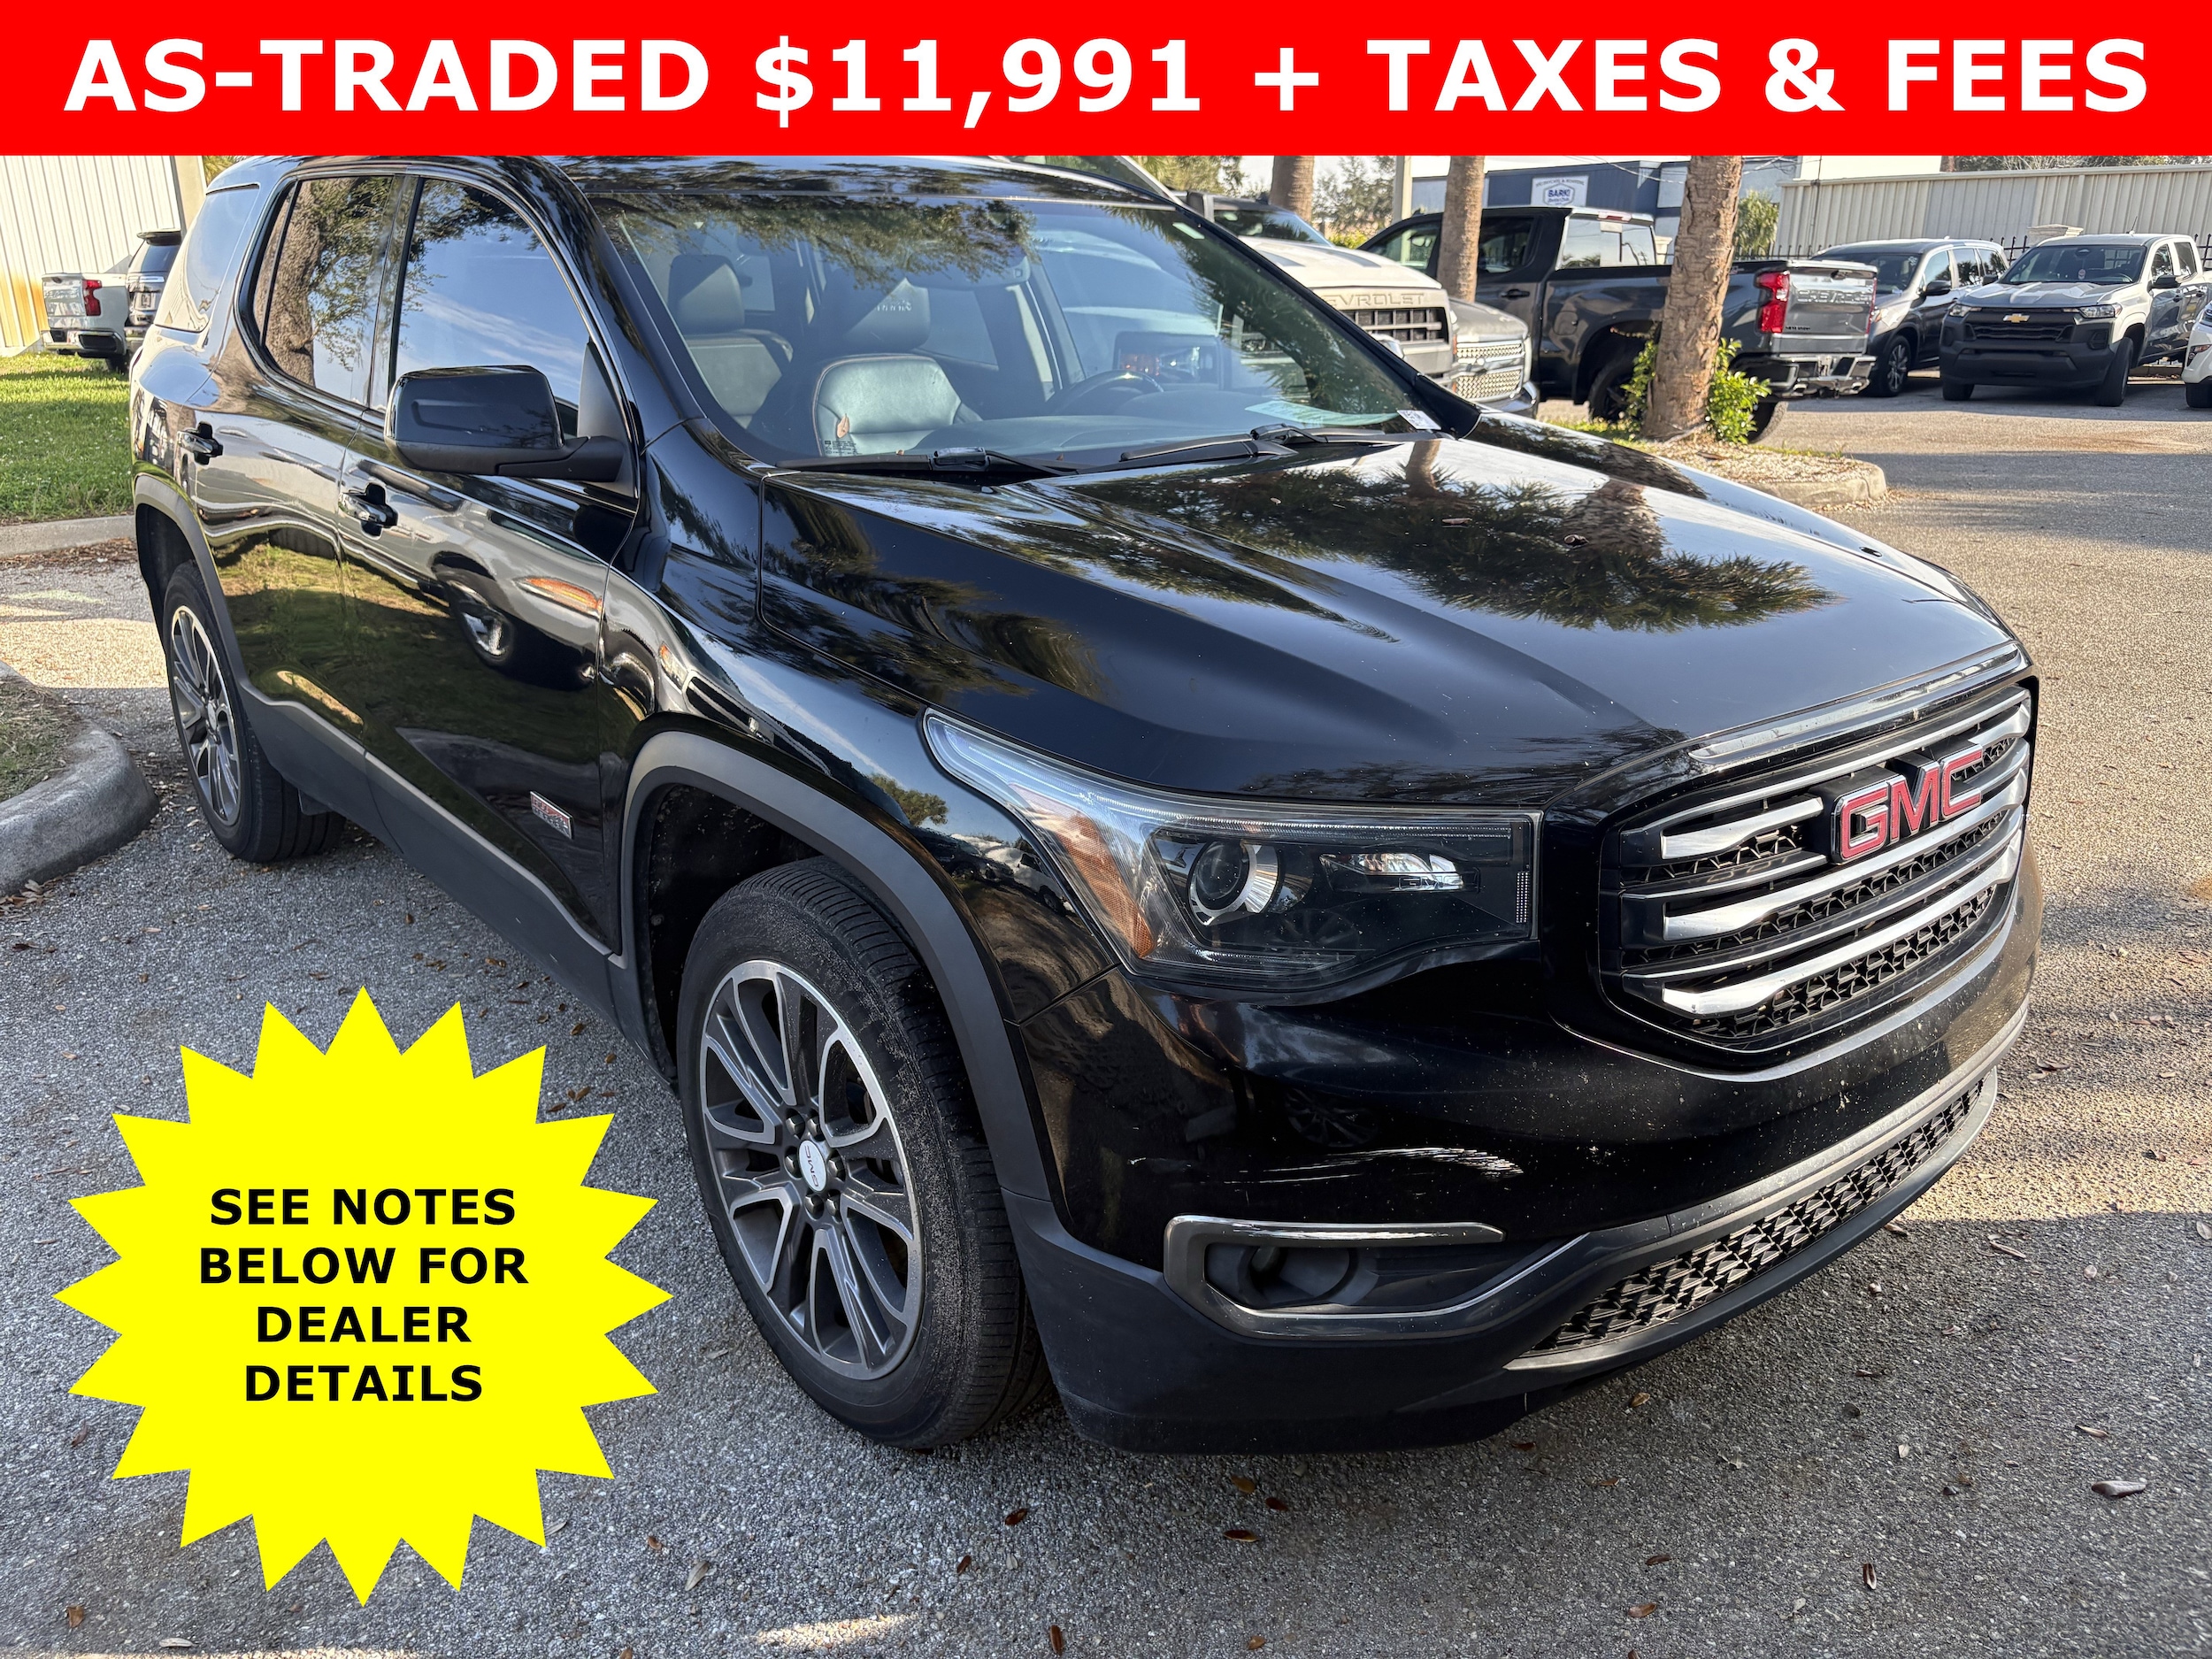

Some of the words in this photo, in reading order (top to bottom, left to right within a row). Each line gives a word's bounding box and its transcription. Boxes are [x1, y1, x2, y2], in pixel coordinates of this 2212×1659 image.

[1322, 293, 1425, 306] EVROLET
[1831, 743, 1984, 864] GMC
[804, 1145, 819, 1187] GMC
